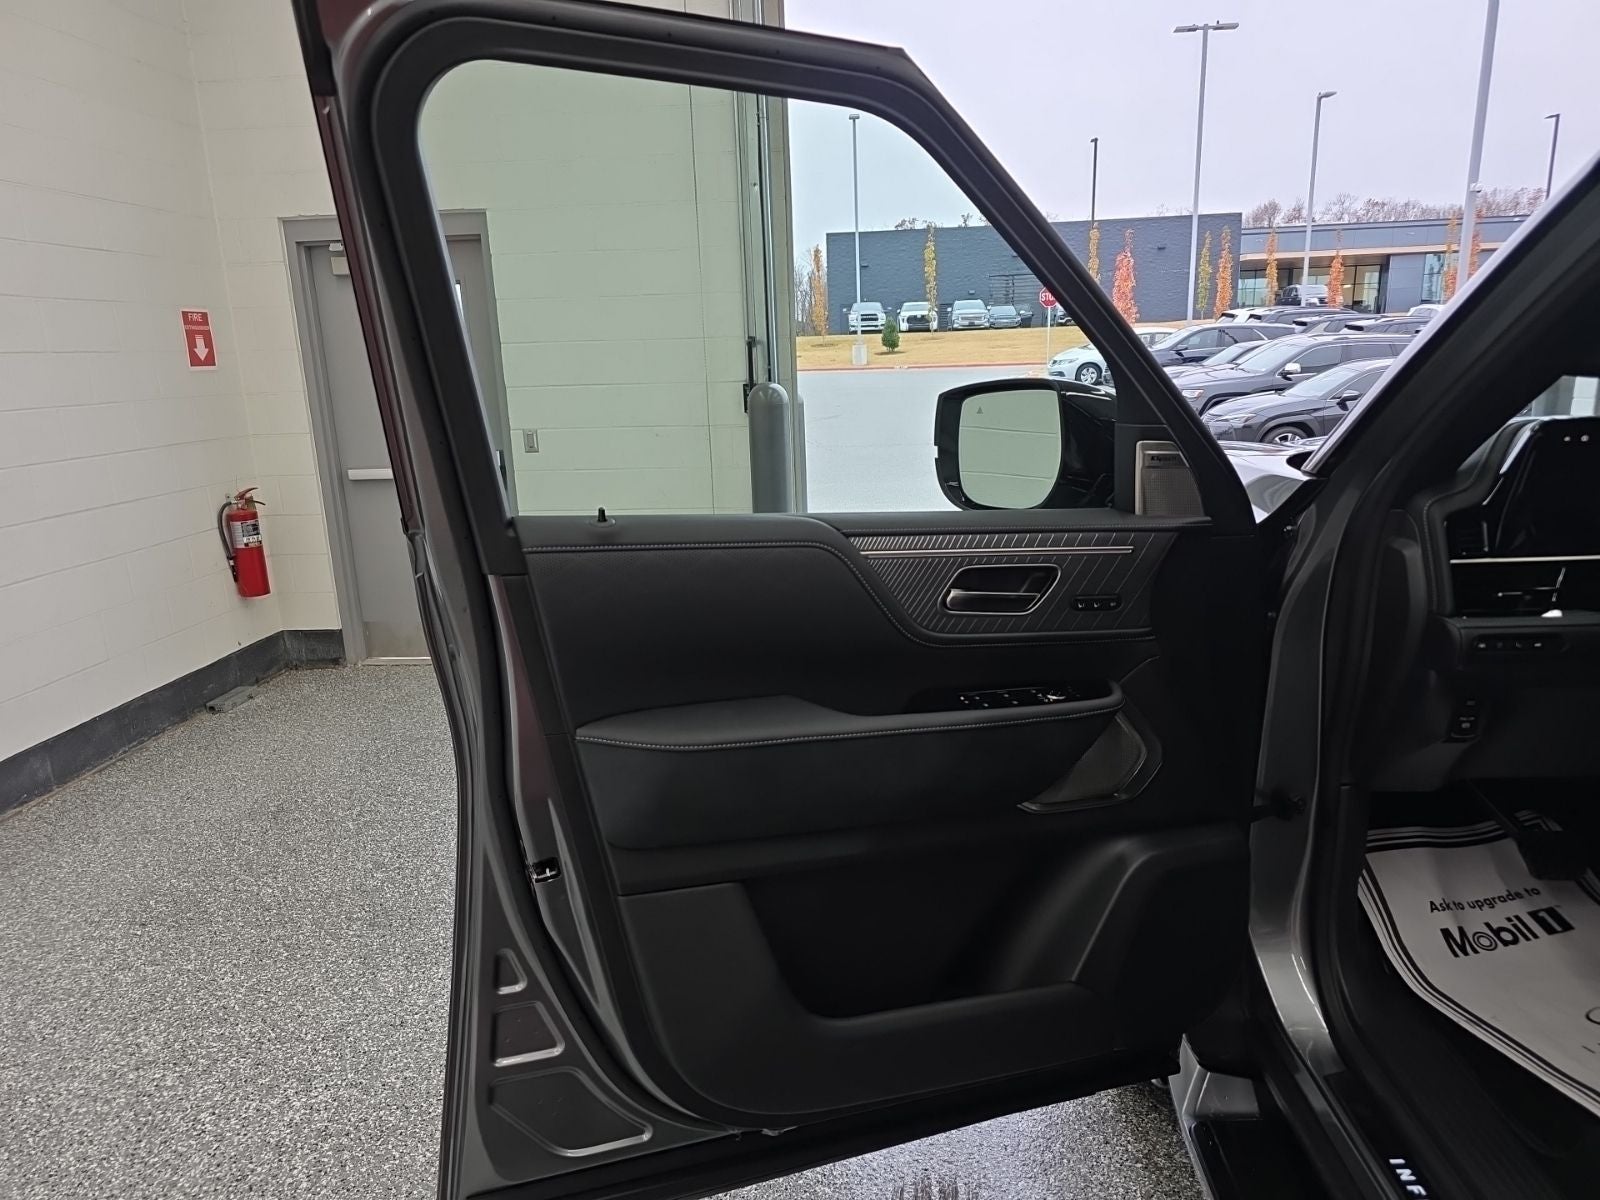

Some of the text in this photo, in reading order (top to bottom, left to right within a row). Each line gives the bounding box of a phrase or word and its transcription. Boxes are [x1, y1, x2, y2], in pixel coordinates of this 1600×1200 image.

[1041, 292, 1056, 301] STO
[188, 312, 204, 322] FIRE
[1429, 887, 1541, 913] Ask to upgrade to
[1439, 914, 1540, 958] Mobil
[1389, 1158, 1428, 1200] INF
